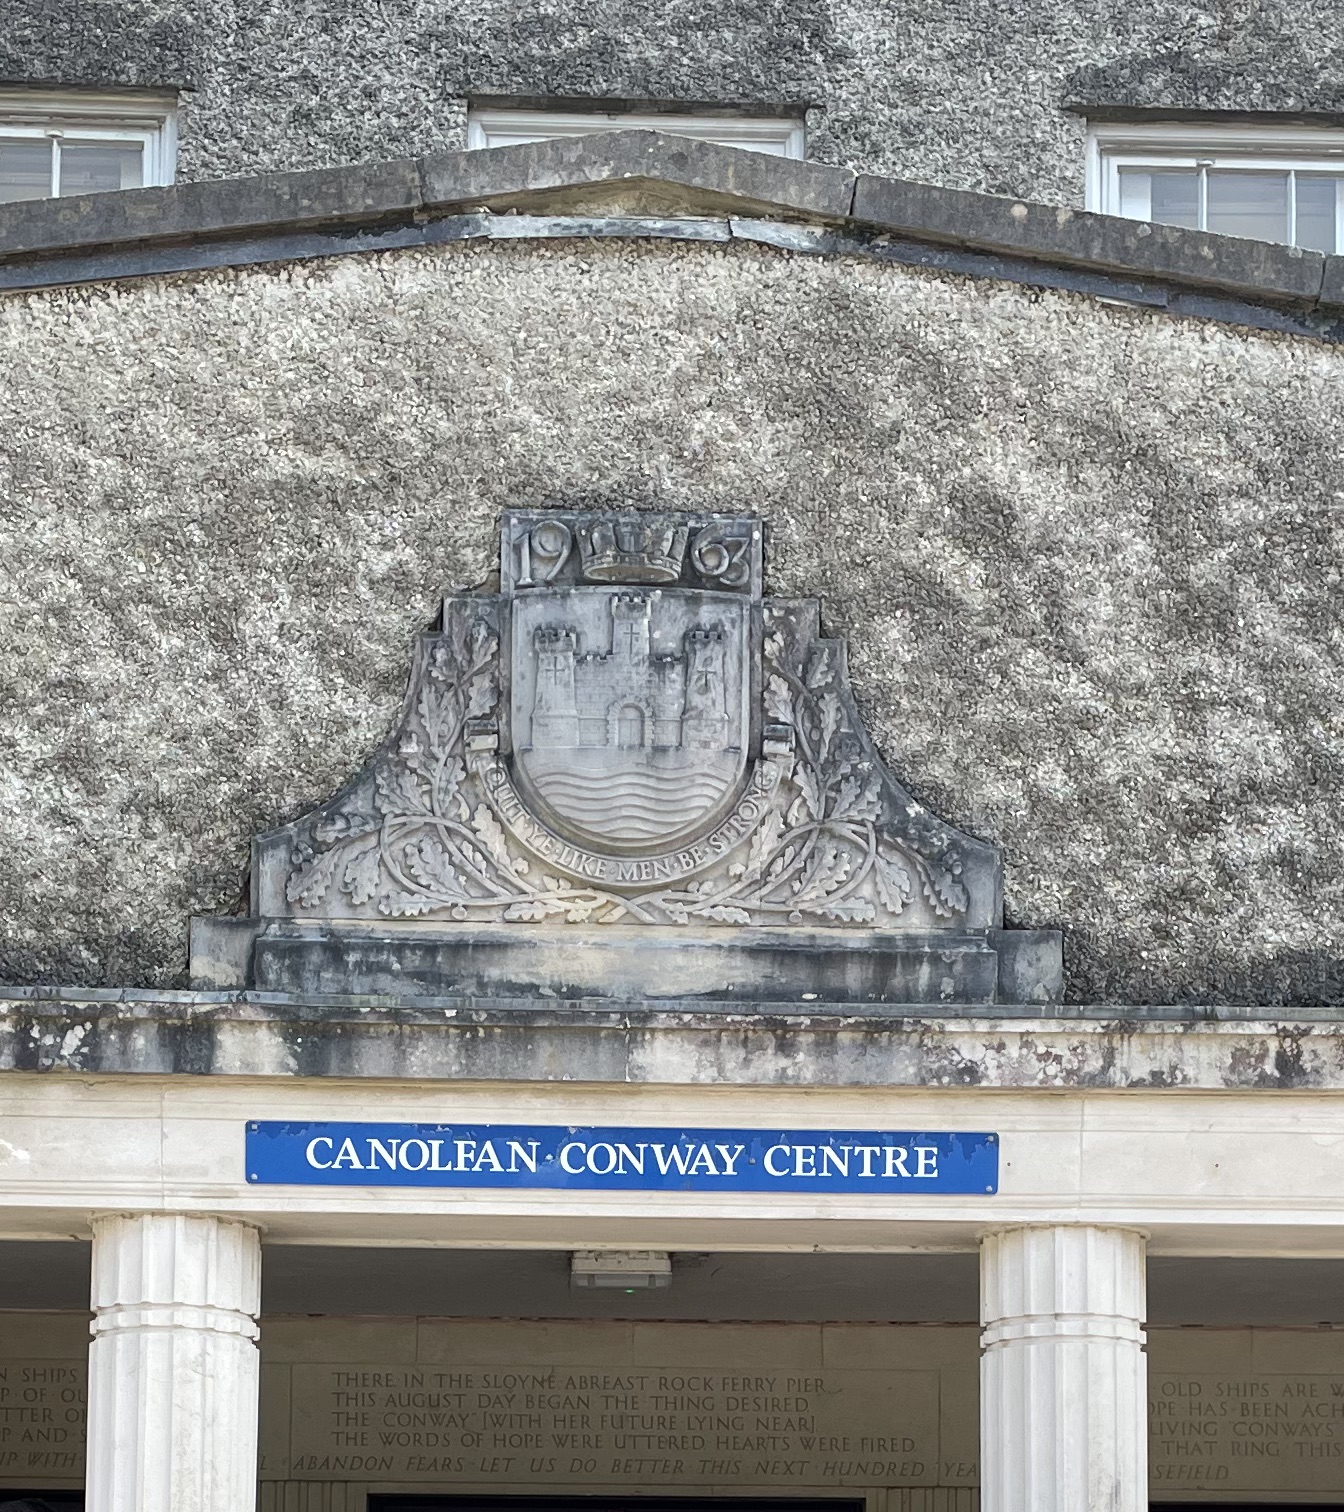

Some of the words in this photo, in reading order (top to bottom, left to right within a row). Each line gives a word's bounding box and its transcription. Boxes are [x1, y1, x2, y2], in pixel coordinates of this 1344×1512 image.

[513, 520, 571, 585] 19
[691, 522, 751, 586] 63
[527, 825, 555, 854] YE
[557, 850, 607, 878] LIKE
[615, 861, 671, 882] MEN
[675, 848, 707, 872] BE
[710, 764, 778, 854] STRONG
[305, 1136, 542, 1174] CANOLFAN
[560, 1141, 745, 1176] CONWAY
[762, 1144, 939, 1179] CENTRE
[20, 1367, 78, 1384] SHIPS
[331, 1371, 397, 1388] THERE
[403, 1372, 425, 1388] IN
[434, 1372, 474, 1389] THE
[480, 1373, 557, 1391] SLOYNE
[563, 1374, 650, 1391] ABREAST
[659, 1376, 714, 1393] ROCK
[721, 1376, 778, 1393] FERRY
[22, 1387, 48, 1403] OF
[60, 1388, 86, 1404] OU
[1161, 1381, 1203, 1398] OLD
[1214, 1381, 1270, 1398] SHIPS
[1281, 1382, 1319, 1398] ARE
[331, 1391, 377, 1407] THIS
[384, 1392, 467, 1409] AUGUST
[477, 1393, 517, 1409] DAY
[524, 1394, 591, 1410] BEGAN
[599, 1394, 639, 1411] THE
[649, 1395, 715, 1412] THING
[1149, 1401, 1177, 1417] PE
[1188, 1401, 1228, 1417] HAS
[1240, 1402, 1289, 1418] BEEN
[331, 1411, 370, 1427] THE
[553, 1414, 592, 1430] HER
[600, 1415, 677, 1431] FUTURE
[687, 1415, 745, 1432] LYING
[20, 1427, 68, 1443] AND
[331, 1431, 370, 1447] THE
[378, 1432, 451, 1448] WORDS
[460, 1432, 484, 1448] OF
[493, 1433, 544, 1449] HOPE
[551, 1434, 603, 1449] WERE
[716, 1435, 791, 1452] HEARTS
[799, 1436, 851, 1452] WERE
[1161, 1440, 1218, 1456] THAT
[1230, 1441, 1280, 1457] RING
[1293, 1442, 1342, 1457] THIS
[27, 1452, 78, 1468] WITH
[292, 1455, 394, 1471] ABANDON
[406, 1456, 466, 1472] FEARS
[479, 1457, 517, 1473] LET
[529, 1457, 558, 1473] US
[569, 1457, 597, 1473] DO
[611, 1458, 685, 1474] BETTER
[698, 1459, 743, 1476] THIS
[754, 1460, 811, 1476] NEXT
[822, 1461, 926, 1478] HUNDRED
[944, 1462, 978, 1478] YEA
[1152, 1464, 1230, 1481] SEFIELD
